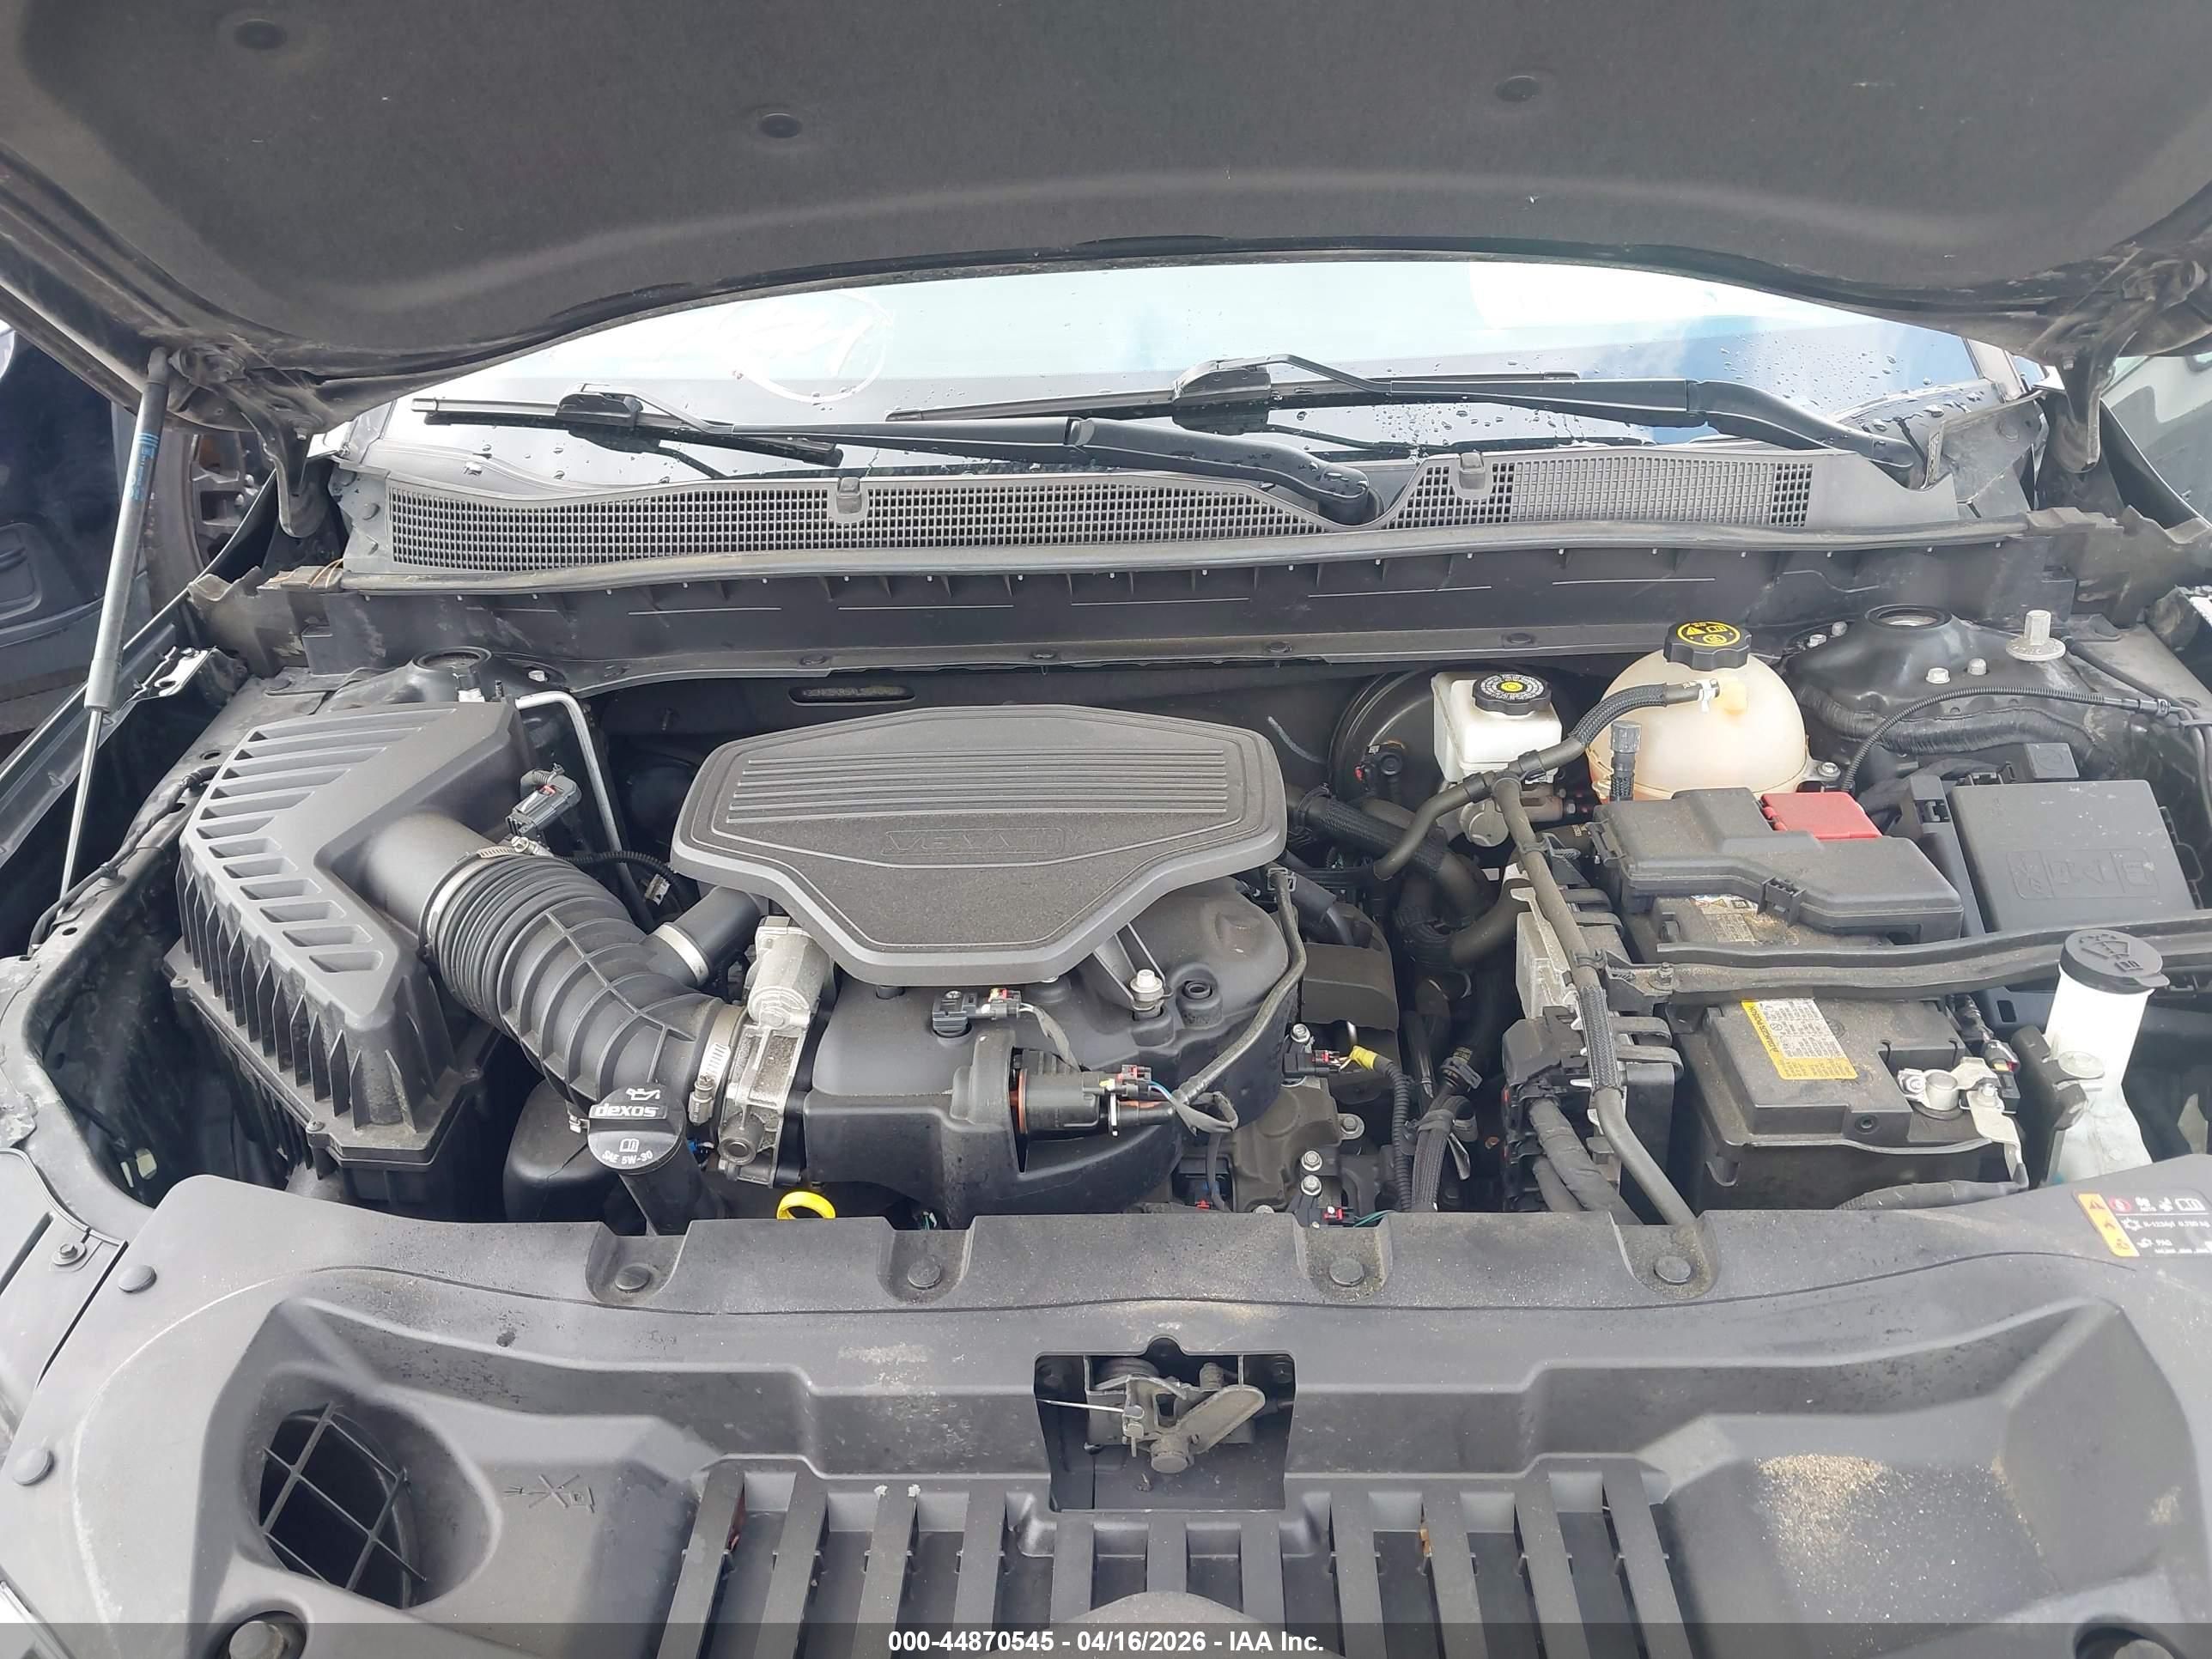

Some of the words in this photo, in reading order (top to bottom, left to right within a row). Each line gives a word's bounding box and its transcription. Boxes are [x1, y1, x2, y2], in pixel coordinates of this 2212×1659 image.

[594, 1103, 659, 1117] dexos
[602, 1150, 619, 1164] SAE
[621, 1151, 653, 1164] 5W-30
